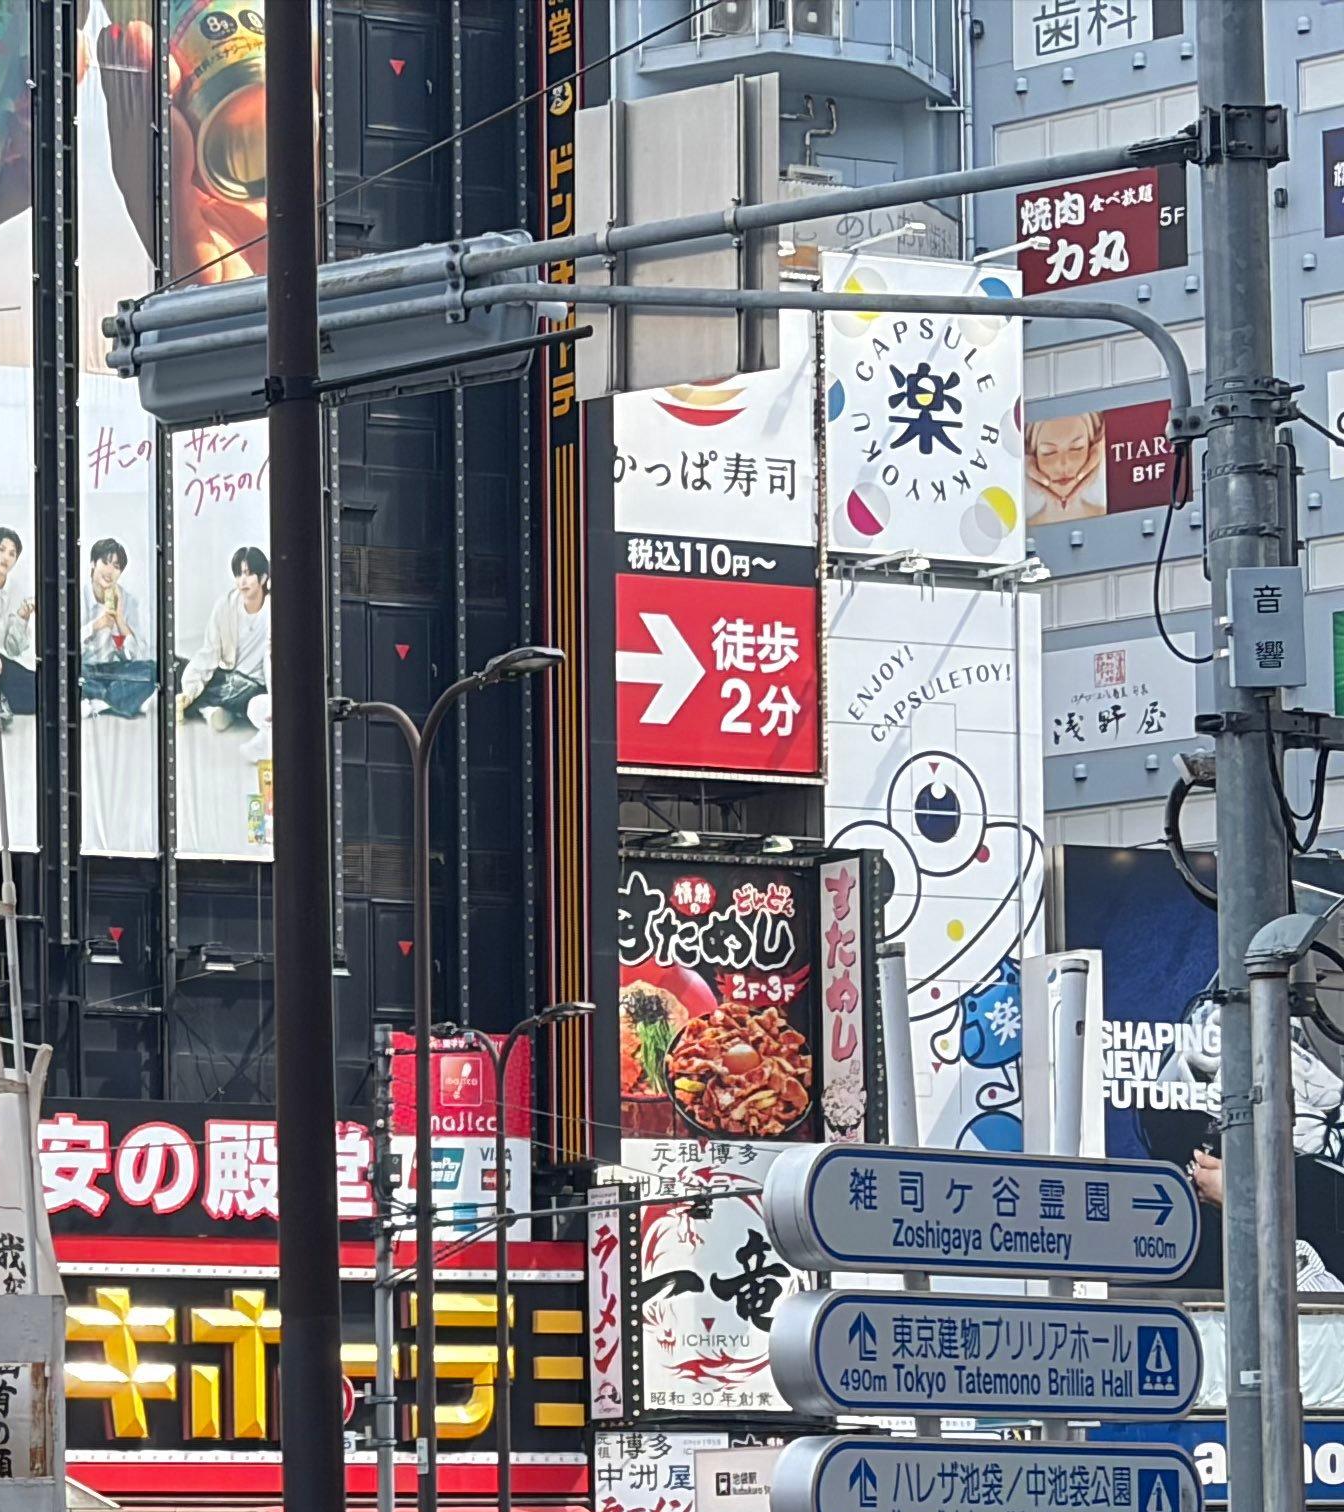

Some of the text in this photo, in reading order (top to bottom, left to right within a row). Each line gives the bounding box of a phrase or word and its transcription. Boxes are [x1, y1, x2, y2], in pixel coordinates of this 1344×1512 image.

[1021, 191, 1085, 235] 焼肉
[1159, 205, 1186, 227] 5F
[1046, 230, 1129, 284] 力丸
[855, 318, 996, 393] CAPSULE
[888, 362, 963, 455] 楽
[1132, 463, 1166, 484] B1F
[1253, 585, 1285, 669] 音響
[711, 617, 799, 674] 徒歩
[848, 644, 915, 721] ENJOY!
[720, 678, 802, 736] 2分
[1100, 1020, 1222, 1051] SHAPING
[1100, 1080, 1222, 1111] FUTURES
[480, 1147, 513, 1162] VIA
[651, 1142, 759, 1165] 元祖博多
[892, 1218, 1072, 1260] Zoshigaya Cemetery
[1133, 1236, 1177, 1259] 1060m
[591, 1223, 620, 1374] ラーメン
[680, 1333, 751, 1348] ICHIRYU
[840, 1364, 1134, 1399] 490m Tokyo Tatemono Brillia Hall
[616, 1433, 673, 1459] 博多
[597, 1463, 695, 1492] 中洲屋
